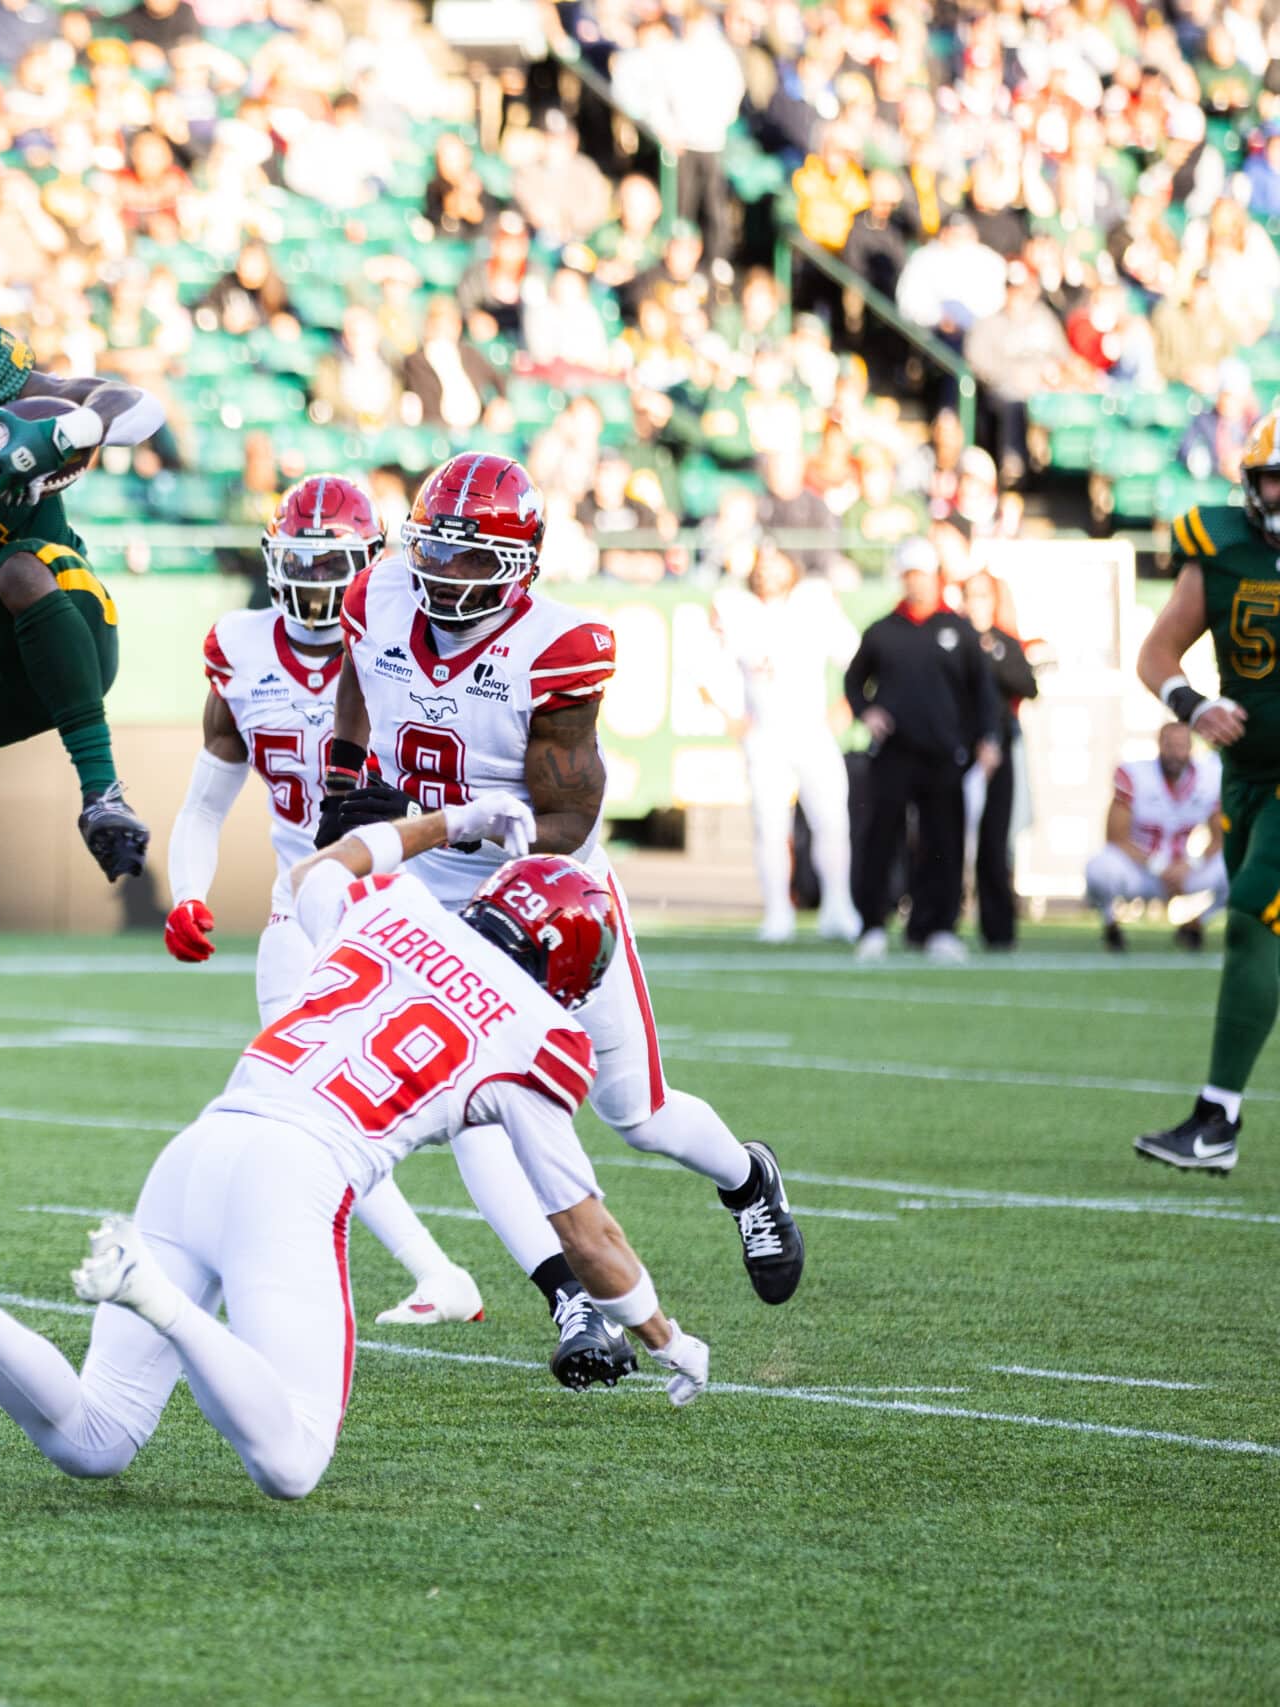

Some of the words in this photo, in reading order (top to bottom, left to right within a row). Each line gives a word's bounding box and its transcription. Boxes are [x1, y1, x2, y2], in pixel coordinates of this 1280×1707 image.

[375, 657, 413, 678] Western
[250, 688, 289, 698] Western
[465, 686, 509, 702] alberta
[482, 679, 510, 693] play
[396, 721, 473, 811] 8
[502, 882, 548, 921] 29
[357, 908, 516, 1037] LABROSSE
[243, 939, 477, 1139] 29
